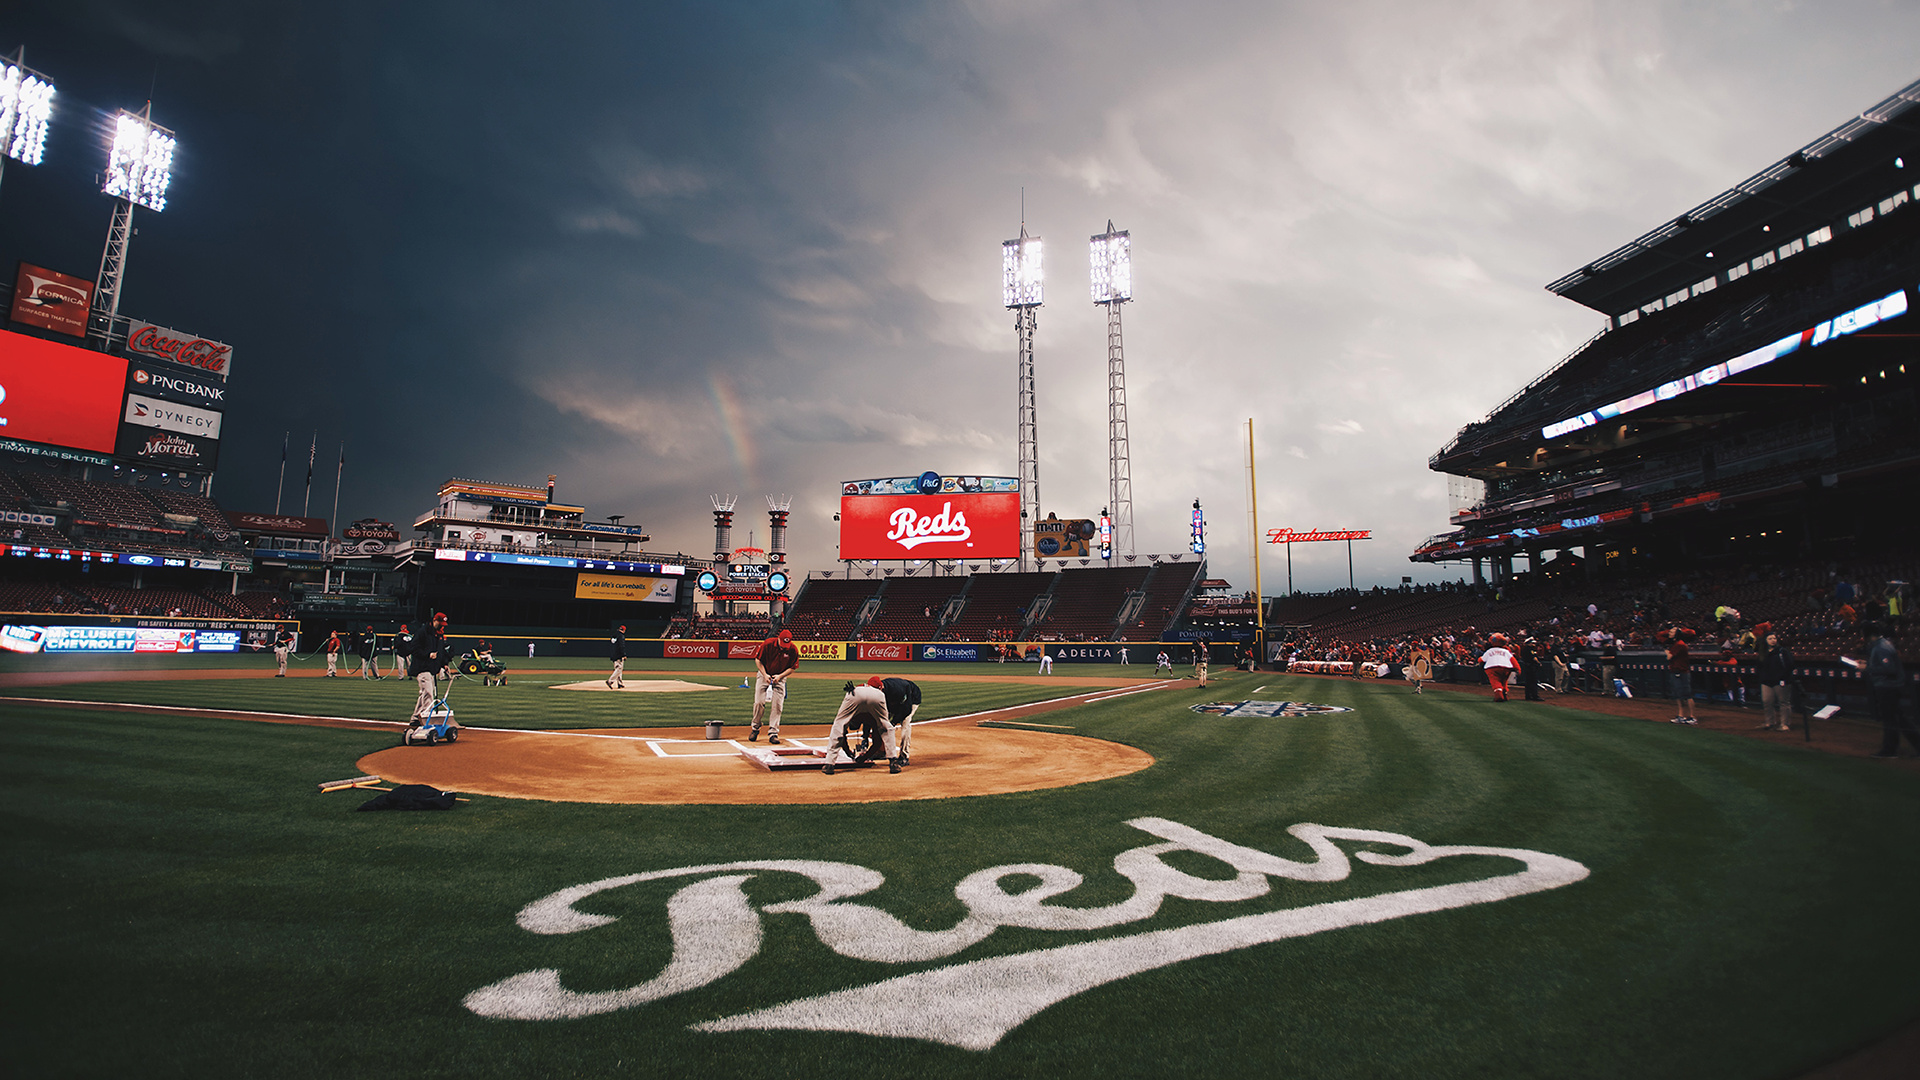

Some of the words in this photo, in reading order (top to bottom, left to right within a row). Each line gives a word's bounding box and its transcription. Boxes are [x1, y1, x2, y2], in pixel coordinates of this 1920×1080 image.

[38, 288, 84, 306] FORMICA
[19, 306, 49, 318] SURFACES
[50, 314, 65, 322] THAT
[65, 318, 82, 327] SHINE
[154, 409, 213, 428] DYNEGY
[163, 435, 187, 445] John
[138, 441, 200, 457] Morrell
[61, 452, 107, 465] SHUTTLE
[922, 478, 939, 487] P&G
[1555, 491, 1573, 501] JACK
[626, 526, 642, 535] Bell
[887, 501, 971, 550] Reds
[362, 530, 394, 538] TOYOTA
[1267, 527, 1370, 545] Budweiser
[743, 565, 763, 573] PNC
[48, 629, 137, 640] McCLUSKEY
[47, 639, 136, 649] CHEVROLET
[800, 643, 838, 654] OLLIE'S
[945, 648, 976, 656] Elizabeth
[1070, 649, 1112, 657] DELTA
[463, 816, 1592, 1050] Reds
